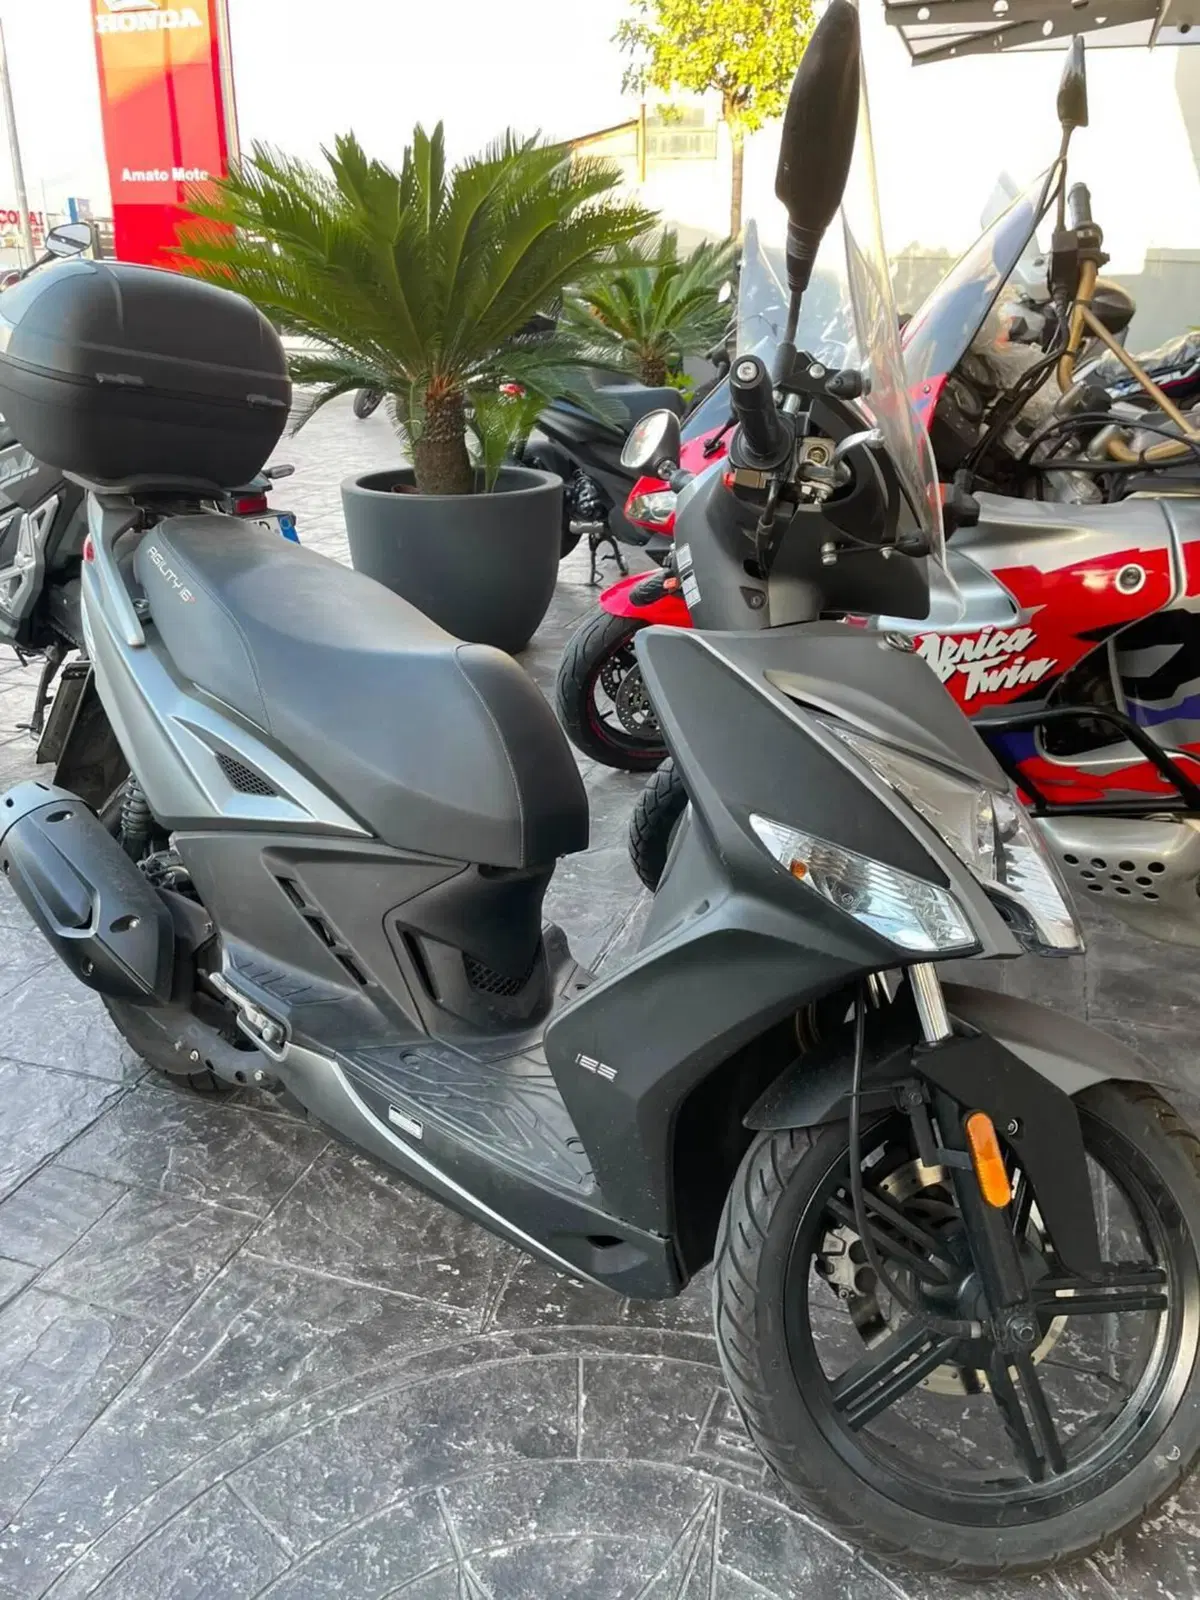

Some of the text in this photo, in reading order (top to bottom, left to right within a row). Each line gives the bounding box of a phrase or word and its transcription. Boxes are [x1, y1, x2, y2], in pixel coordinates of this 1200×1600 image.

[97, 8, 203, 33] HONDA
[122, 167, 169, 181] Amato
[147, 546, 183, 588] AGILITY
[915, 626, 1037, 684] Africa
[957, 655, 1058, 700] Twin
[574, 1053, 618, 1082] 125
